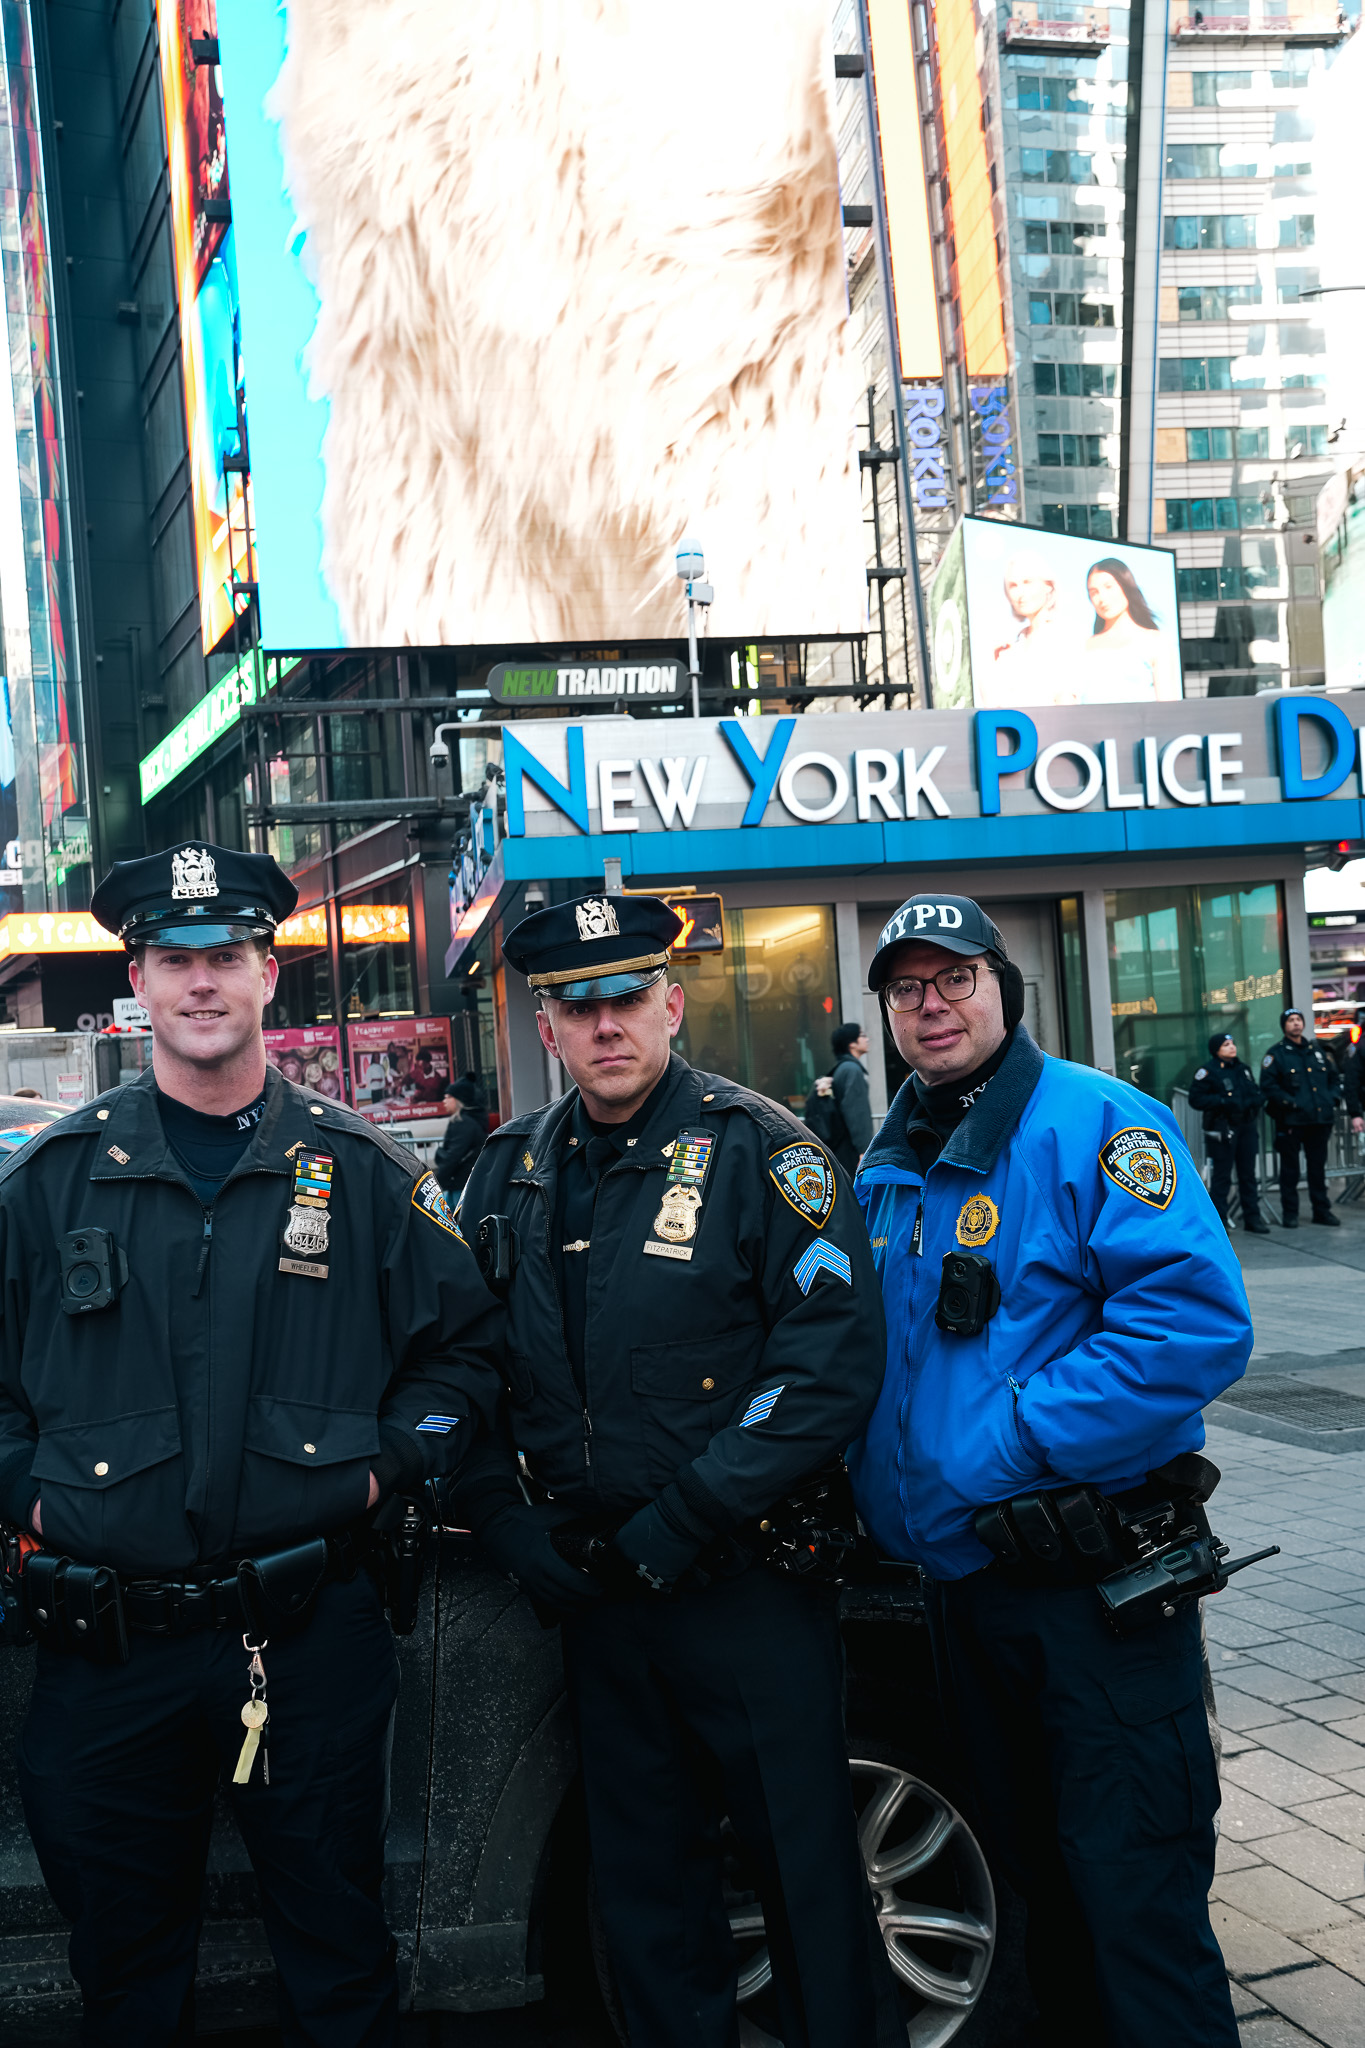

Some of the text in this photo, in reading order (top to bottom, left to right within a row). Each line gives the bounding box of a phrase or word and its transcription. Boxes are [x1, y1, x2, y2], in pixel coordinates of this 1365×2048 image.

[502, 666, 678, 697] NEW TRADITION
[502, 725, 710, 837] NEW
[718, 717, 953, 828] YORK
[974, 709, 1246, 817] POLICE
[881, 904, 963, 947] NYPD
[1107, 1139, 1162, 1165] DEPARTMENT
[1113, 1131, 1148, 1149] POLICE
[776, 1155, 825, 1175] DEPARTMENT
[782, 1147, 814, 1162] POLICE
[1114, 1170, 1150, 1197] CITY OF
[1162, 1153, 1173, 1197] NEW YORK
[783, 1183, 812, 1214] CITY OF
[821, 1170, 834, 1215] NEW YORK
[290, 1232, 325, 1251] 19446
[646, 1244, 689, 1257] FITZPATRICK
[291, 1262, 319, 1274] WHEELER
